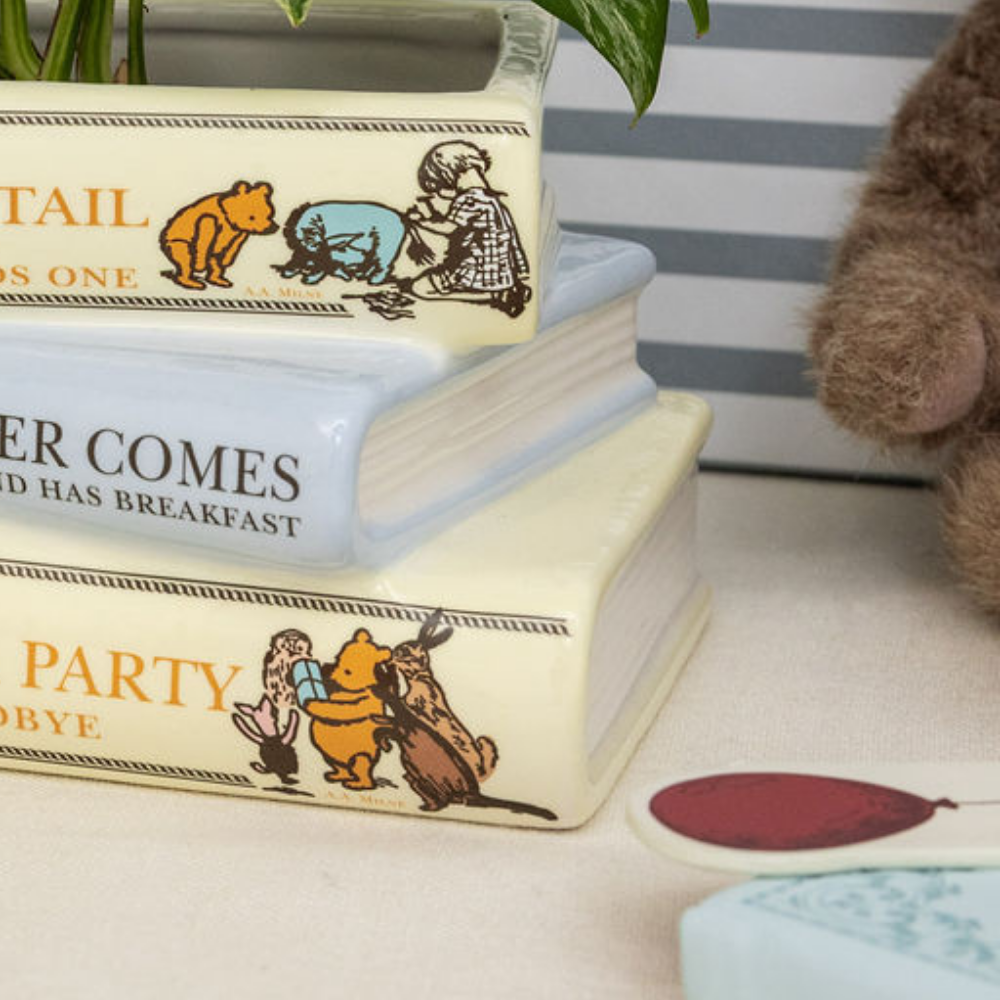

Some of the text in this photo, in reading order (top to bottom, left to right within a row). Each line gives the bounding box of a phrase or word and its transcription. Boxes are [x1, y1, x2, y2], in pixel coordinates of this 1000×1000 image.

[47, 266, 139, 290] ONE
[86, 428, 301, 502] COMES
[39, 478, 102, 507] HAS
[115, 489, 301, 537] BREAKFAST
[21, 640, 243, 713] PARTY
